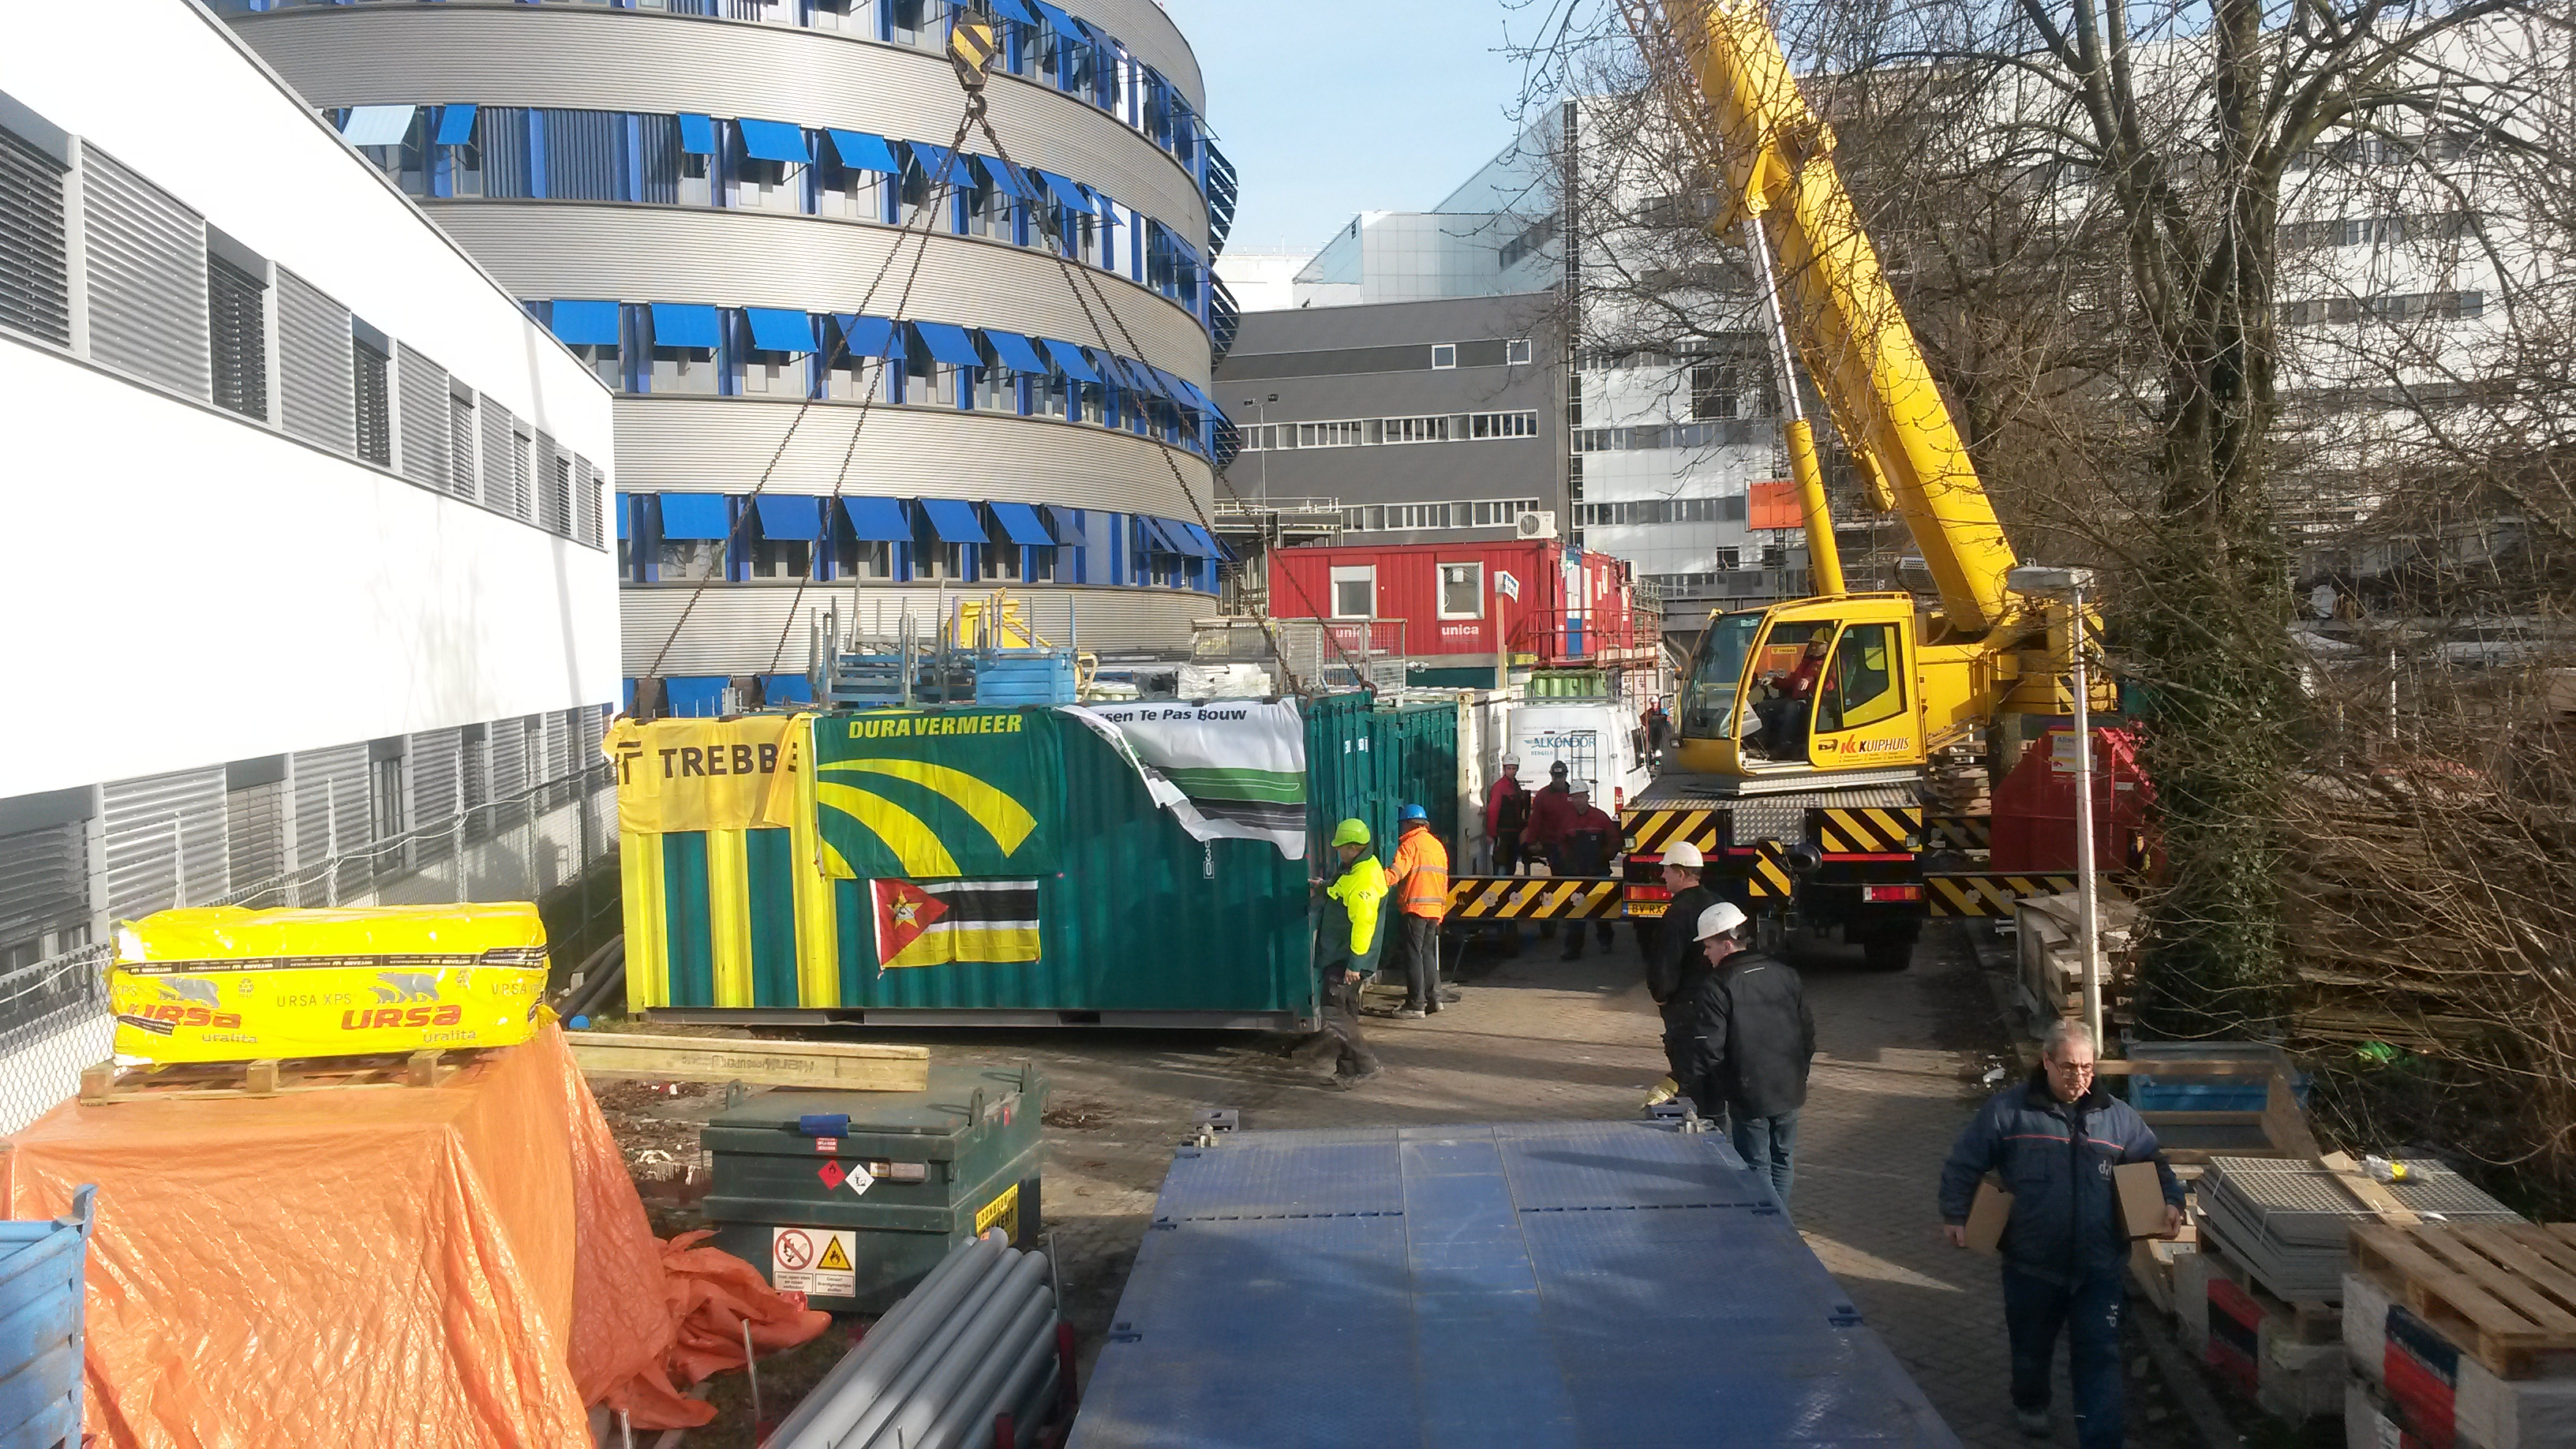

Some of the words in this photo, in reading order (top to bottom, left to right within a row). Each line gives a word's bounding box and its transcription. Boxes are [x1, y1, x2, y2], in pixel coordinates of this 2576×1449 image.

[1441, 624, 1480, 636] unica
[1140, 709, 1157, 721] Te
[1163, 709, 1192, 720] Pas
[1197, 709, 1248, 721] Bouw
[1531, 736, 1596, 749] ALKONDOR
[1859, 736, 1910, 753] KUIPHUIS
[491, 983, 527, 996] URSA
[276, 994, 317, 1008] URSA
[324, 993, 352, 1005] XPS
[200, 1032, 259, 1044] uralita
[422, 1029, 478, 1043] uralita
